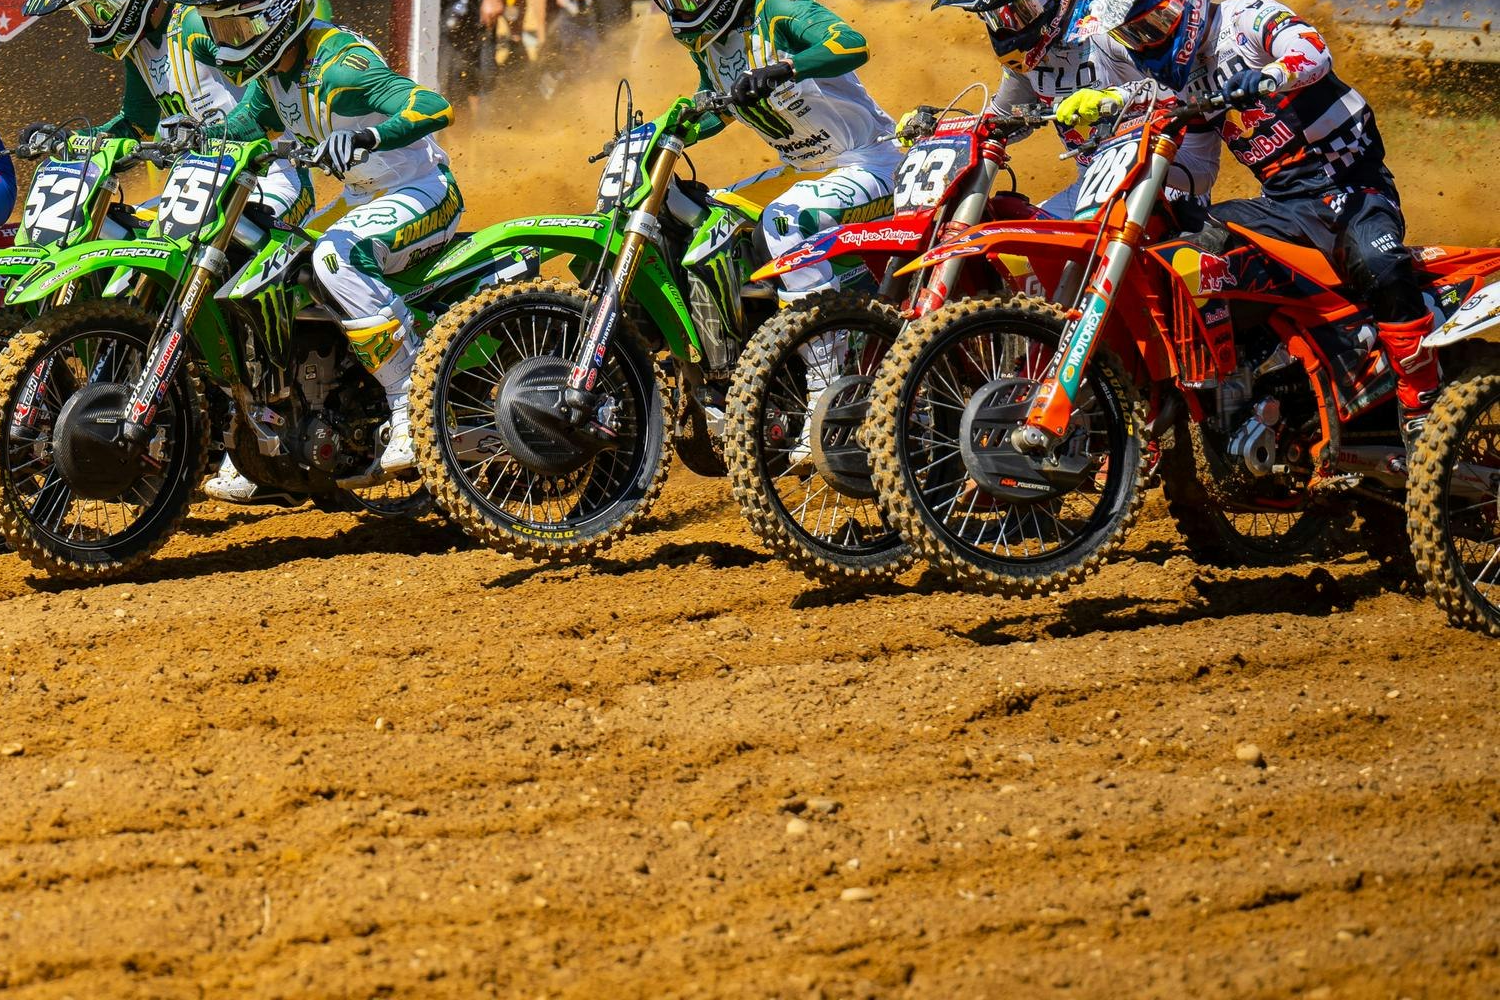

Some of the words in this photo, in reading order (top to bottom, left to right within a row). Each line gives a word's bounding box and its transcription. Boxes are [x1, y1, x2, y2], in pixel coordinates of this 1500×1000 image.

[258, 20, 294, 58] MONSTER
[24, 174, 90, 232] 52
[158, 166, 228, 225] 55
[538, 218, 604, 229] CIRCUIT
[839, 230, 862, 247] Troy
[862, 230, 880, 241] Lee
[880, 228, 922, 245] Designs
[110, 248, 171, 259] CIRCUIT
[615, 244, 635, 291] IRCUIT
[180, 274, 202, 318] RCUIT
[600, 311, 617, 346] PISTONS
[1067, 308, 1102, 366] MOTOREX
[155, 330, 182, 377] BRAKING
[1102, 367, 1134, 436] DUNLOP
[511, 522, 576, 539] DUNLOP
